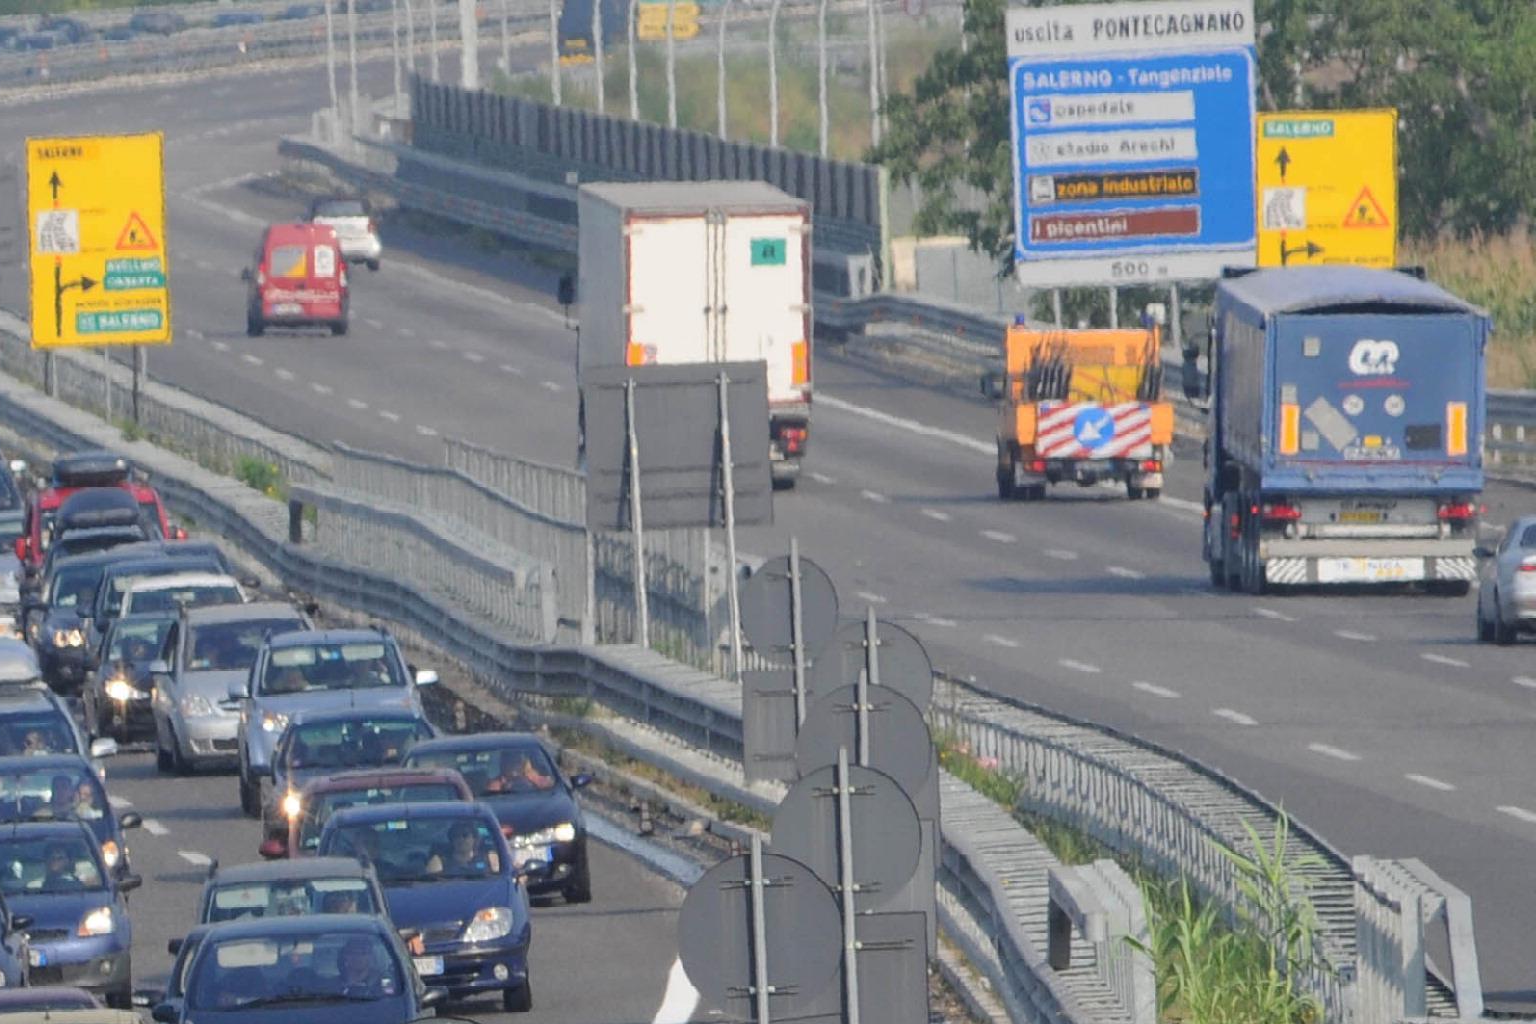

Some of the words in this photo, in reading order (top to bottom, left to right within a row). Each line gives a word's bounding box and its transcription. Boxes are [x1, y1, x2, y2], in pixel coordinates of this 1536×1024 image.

[1014, 20, 1075, 43] uscita
[1092, 11, 1245, 40] PONTECAGNANO
[1022, 69, 1113, 90] SALERNO
[1127, 66, 1233, 88] Tangenziale
[1055, 99, 1135, 119] ospedale
[1266, 121, 1332, 136] SALERNO
[1056, 180, 1099, 199] zona
[1102, 174, 1194, 194] industriale
[1046, 217, 1128, 238] picentini
[1111, 260, 1150, 276] 500
